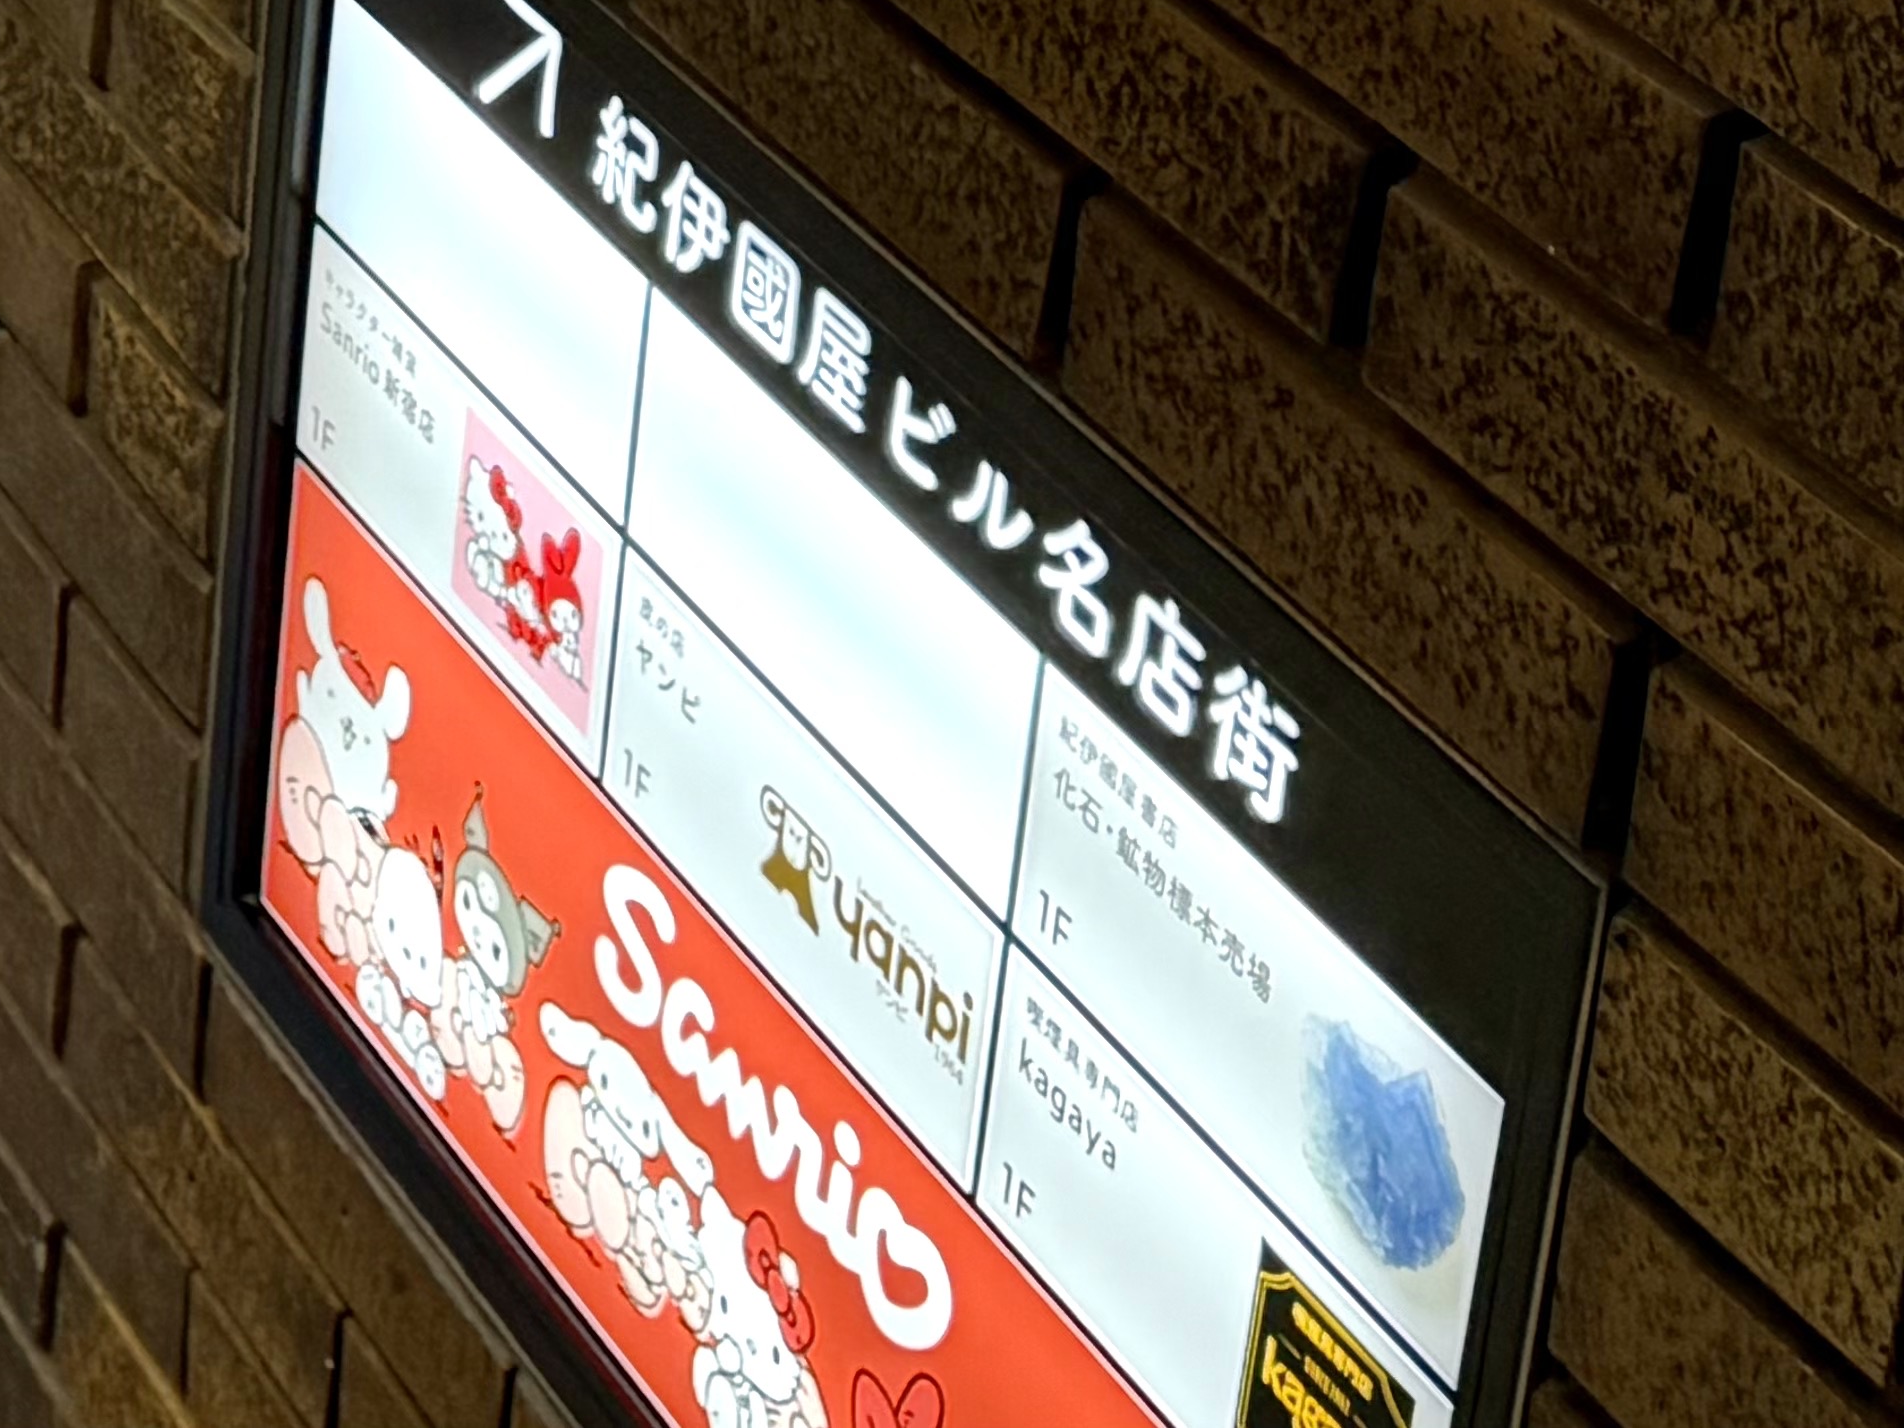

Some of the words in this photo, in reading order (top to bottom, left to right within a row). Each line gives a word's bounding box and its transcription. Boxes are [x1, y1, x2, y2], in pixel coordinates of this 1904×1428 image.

[319, 300, 380, 388] Sanrio
[310, 405, 337, 451] 1F
[588, 92, 1302, 826] 紀伊國屋ビル名店街
[623, 748, 652, 799] 1F
[1038, 888, 1073, 946] 1F
[833, 874, 974, 1066] yanpi
[1018, 1036, 1118, 1171] kagaya
[1002, 1161, 1037, 1218] 1F
